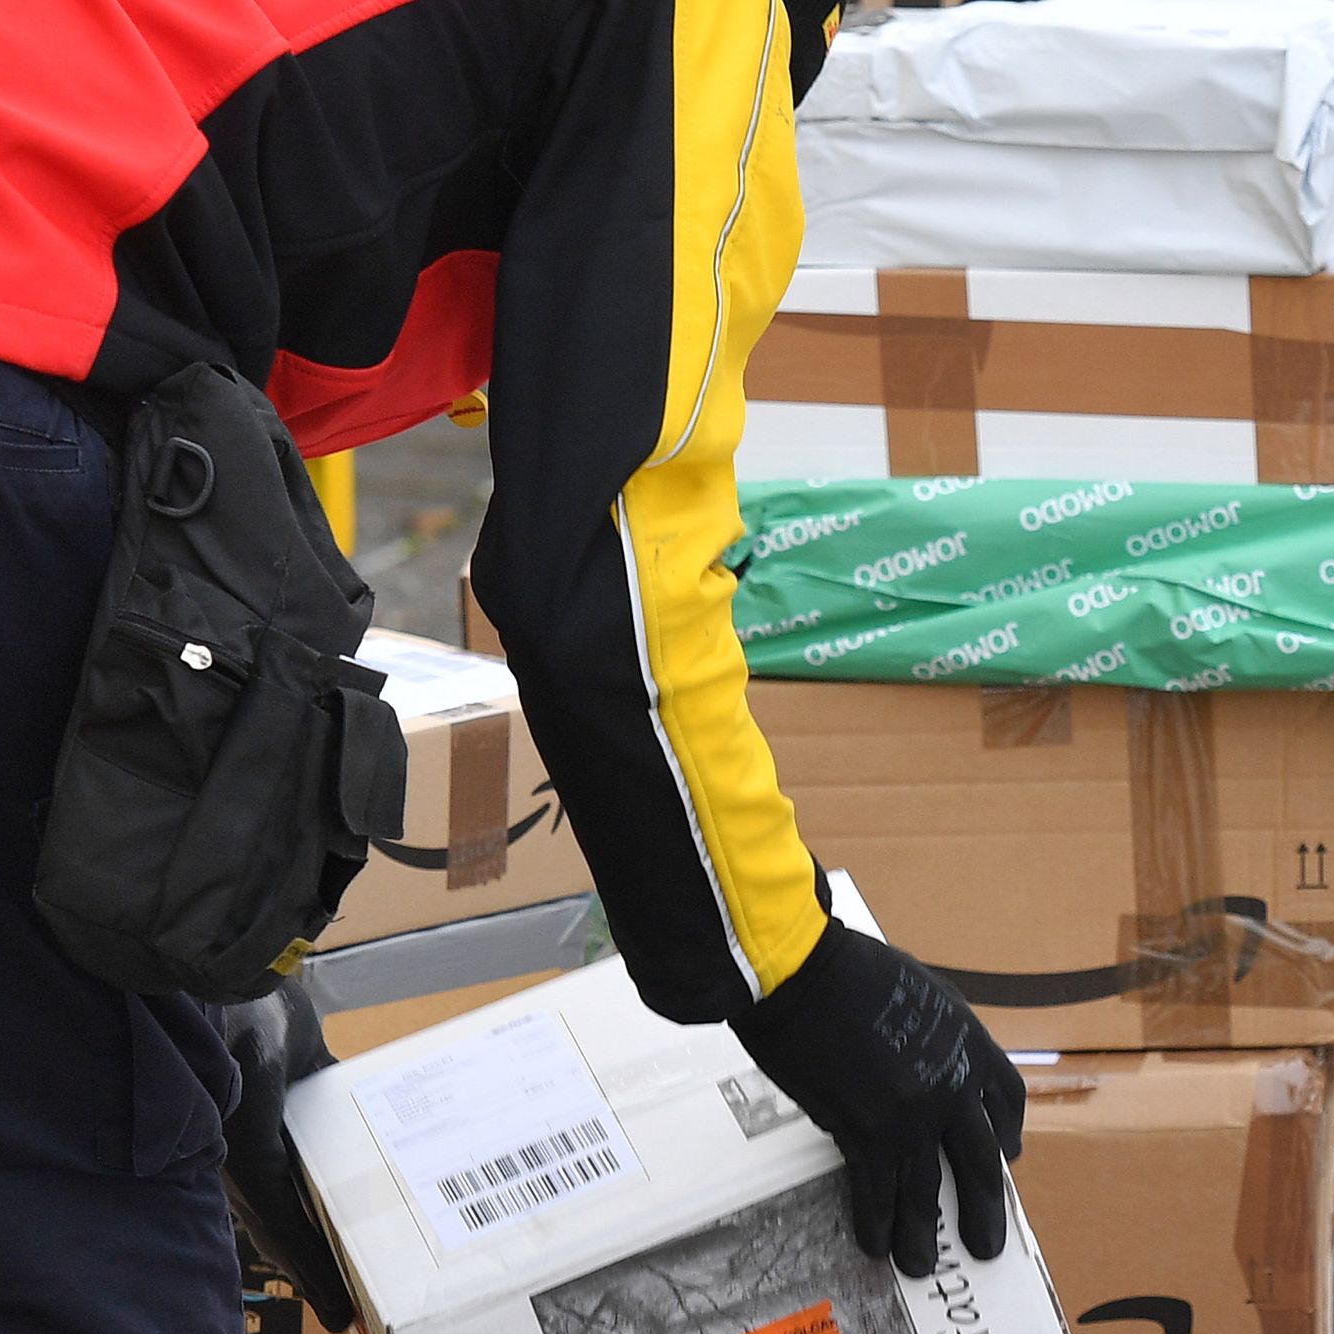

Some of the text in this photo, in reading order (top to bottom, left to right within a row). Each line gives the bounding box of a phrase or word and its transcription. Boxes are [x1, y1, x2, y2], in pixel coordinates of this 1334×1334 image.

[1127, 501, 1242, 557] JOMODO
[853, 531, 968, 589] JOMODO
[912, 621, 1019, 682] JOMODO
